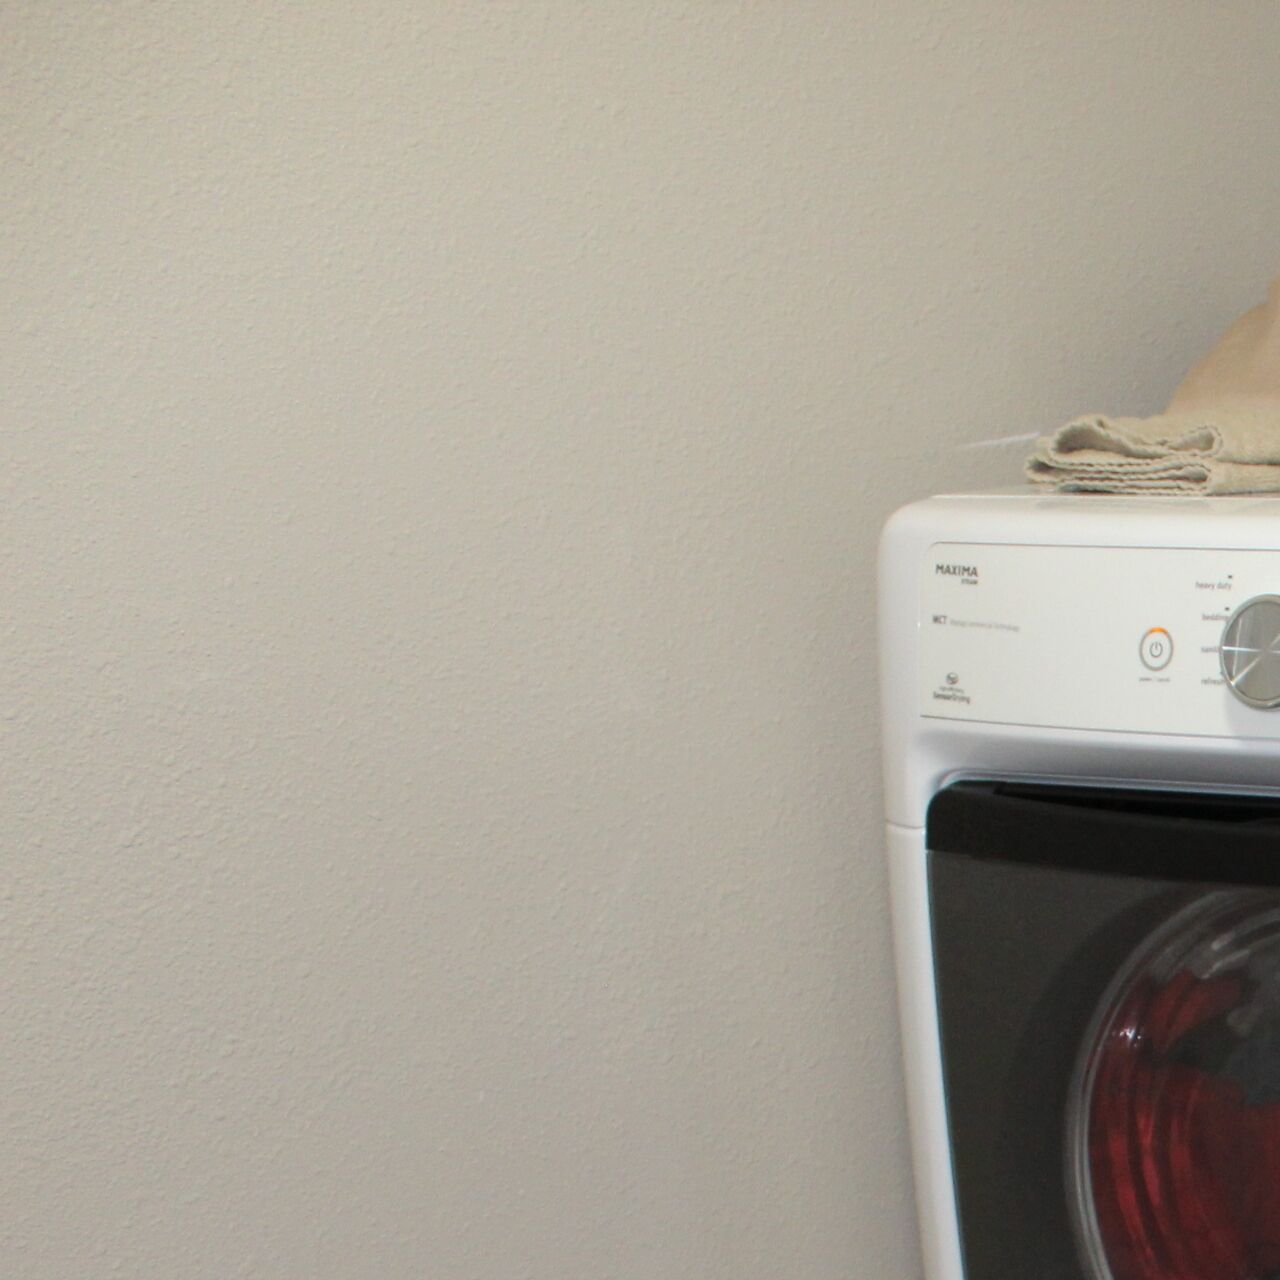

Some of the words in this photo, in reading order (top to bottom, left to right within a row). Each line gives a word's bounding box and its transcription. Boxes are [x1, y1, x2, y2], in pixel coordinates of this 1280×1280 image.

[936, 564, 978, 577] MAXIMA
[1195, 581, 1215, 590] heavy
[1216, 581, 1232, 591] duty
